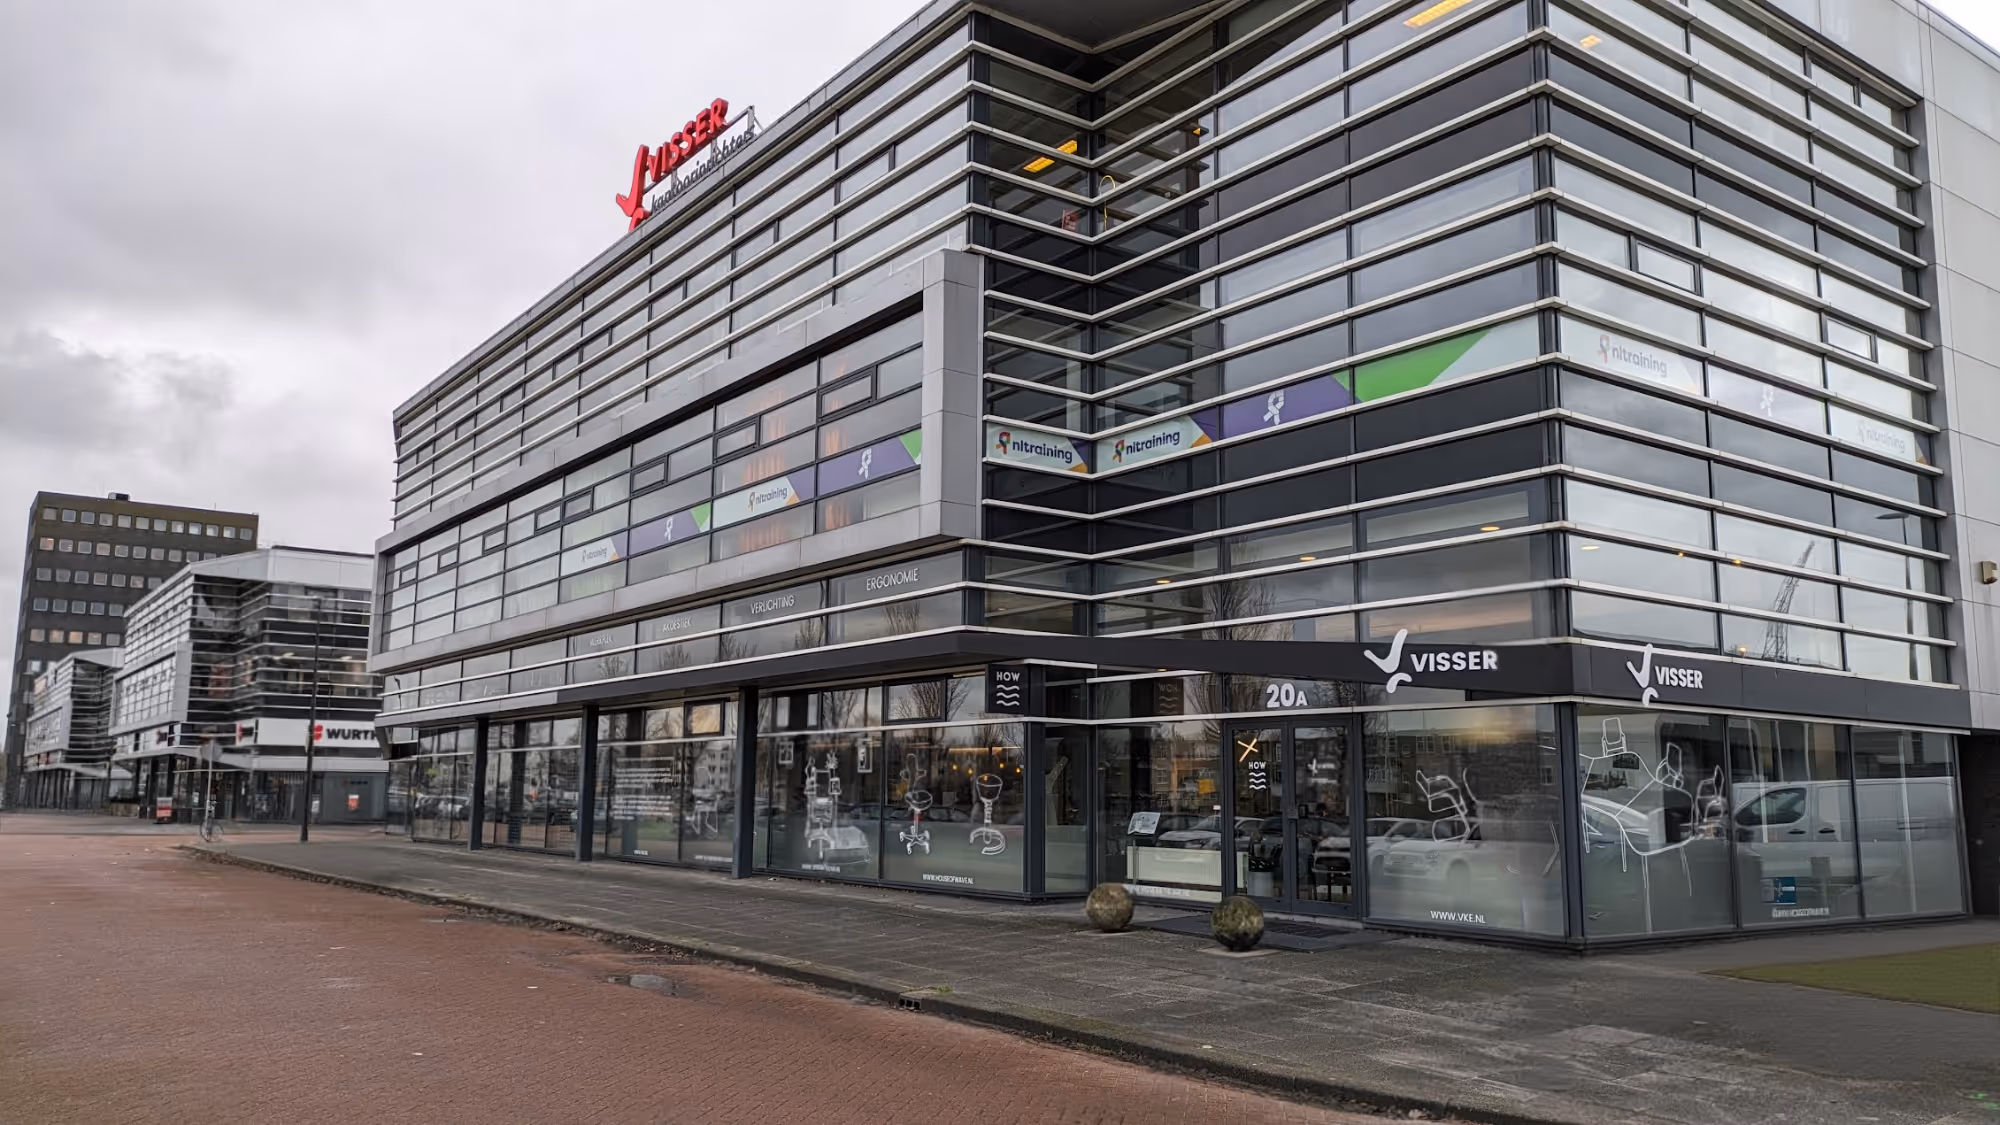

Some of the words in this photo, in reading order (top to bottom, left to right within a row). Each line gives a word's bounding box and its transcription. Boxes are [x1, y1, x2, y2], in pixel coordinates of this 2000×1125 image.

[647, 97, 729, 182] VISSER
[1012, 437, 1073, 464] nltraining
[1126, 430, 1180, 456] nltraining
[866, 568, 918, 591] ERGONOMIE
[751, 595, 795, 614] VERLICHTING
[1410, 649, 1498, 673] VISSER
[996, 671, 1020, 682] HOW
[1655, 665, 1704, 689] VISSER
[1266, 682, 1308, 708] 20A
[1248, 761, 1266, 770] HOW
[1430, 910, 1487, 924] WWW.VKE.NL
